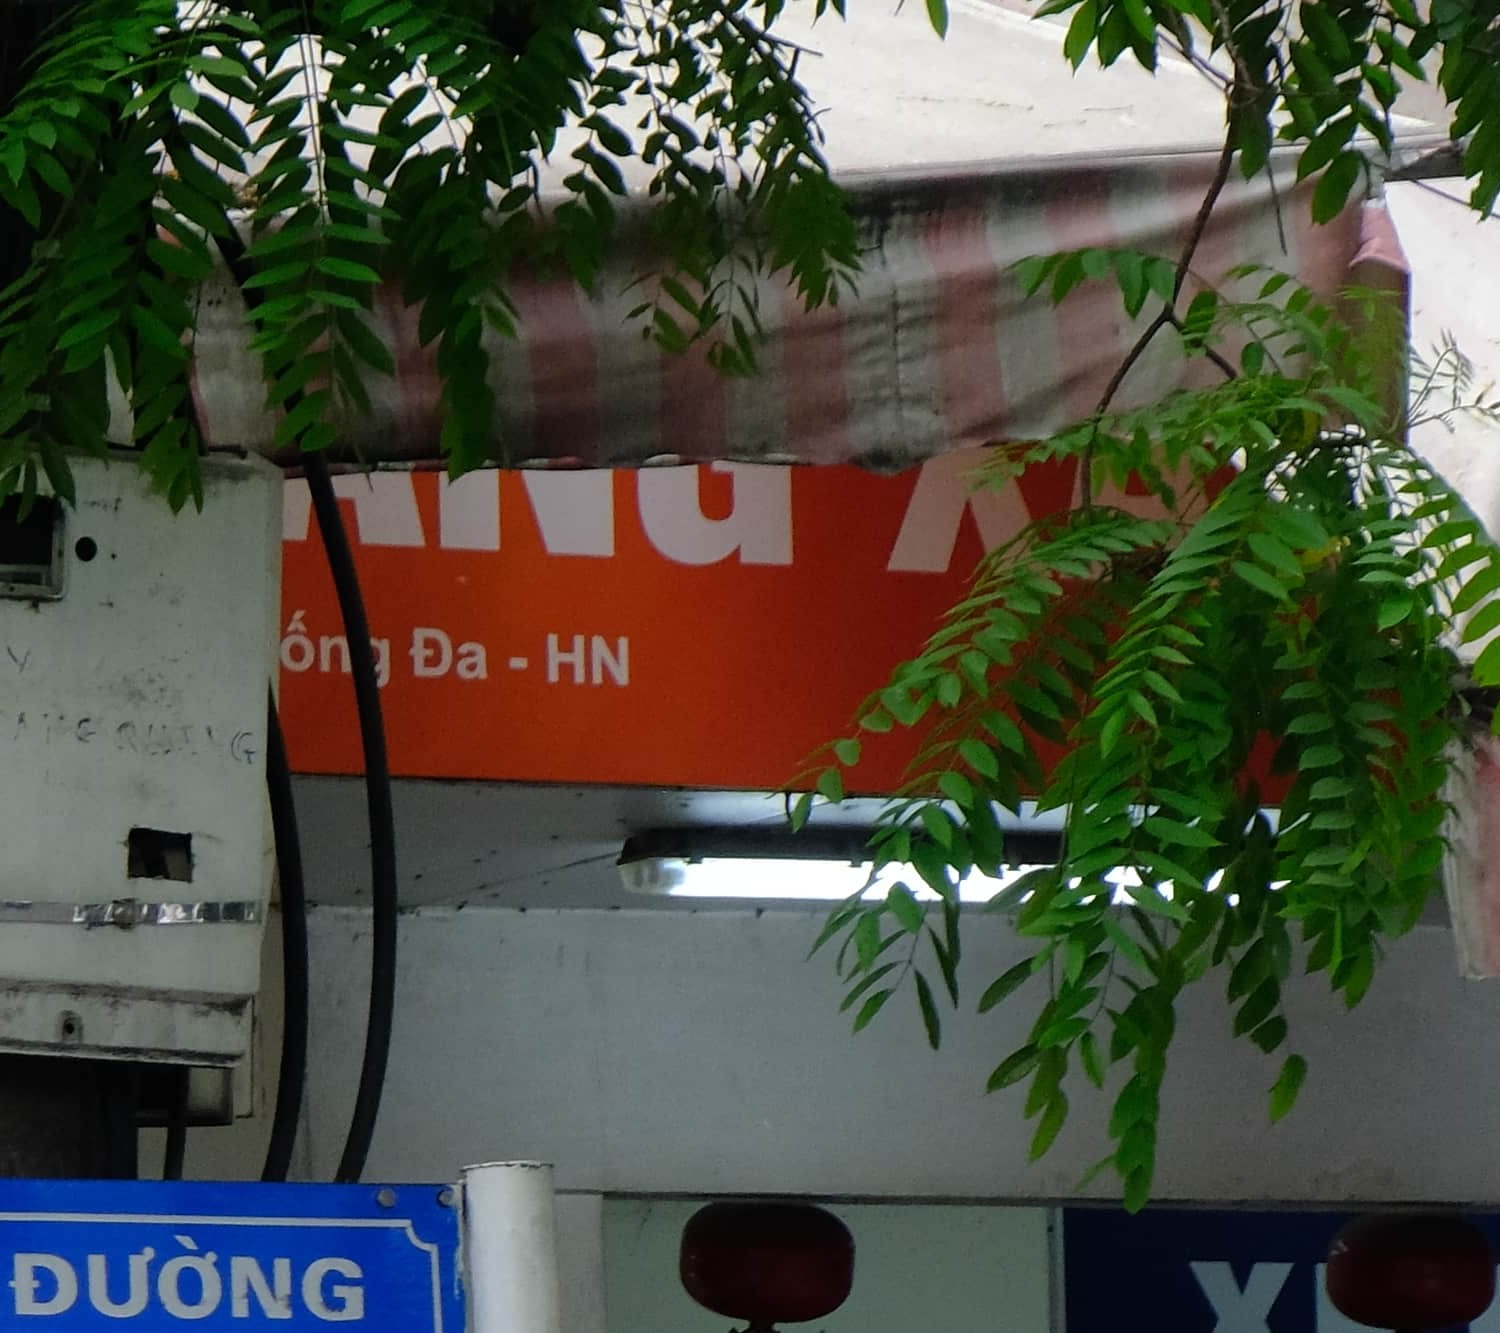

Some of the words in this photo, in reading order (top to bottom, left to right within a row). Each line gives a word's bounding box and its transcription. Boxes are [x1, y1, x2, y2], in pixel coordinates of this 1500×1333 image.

[409, 626, 488, 683] Đa
[546, 633, 631, 687] HN
[8, 1235, 366, 1322] ĐƯỜNG
